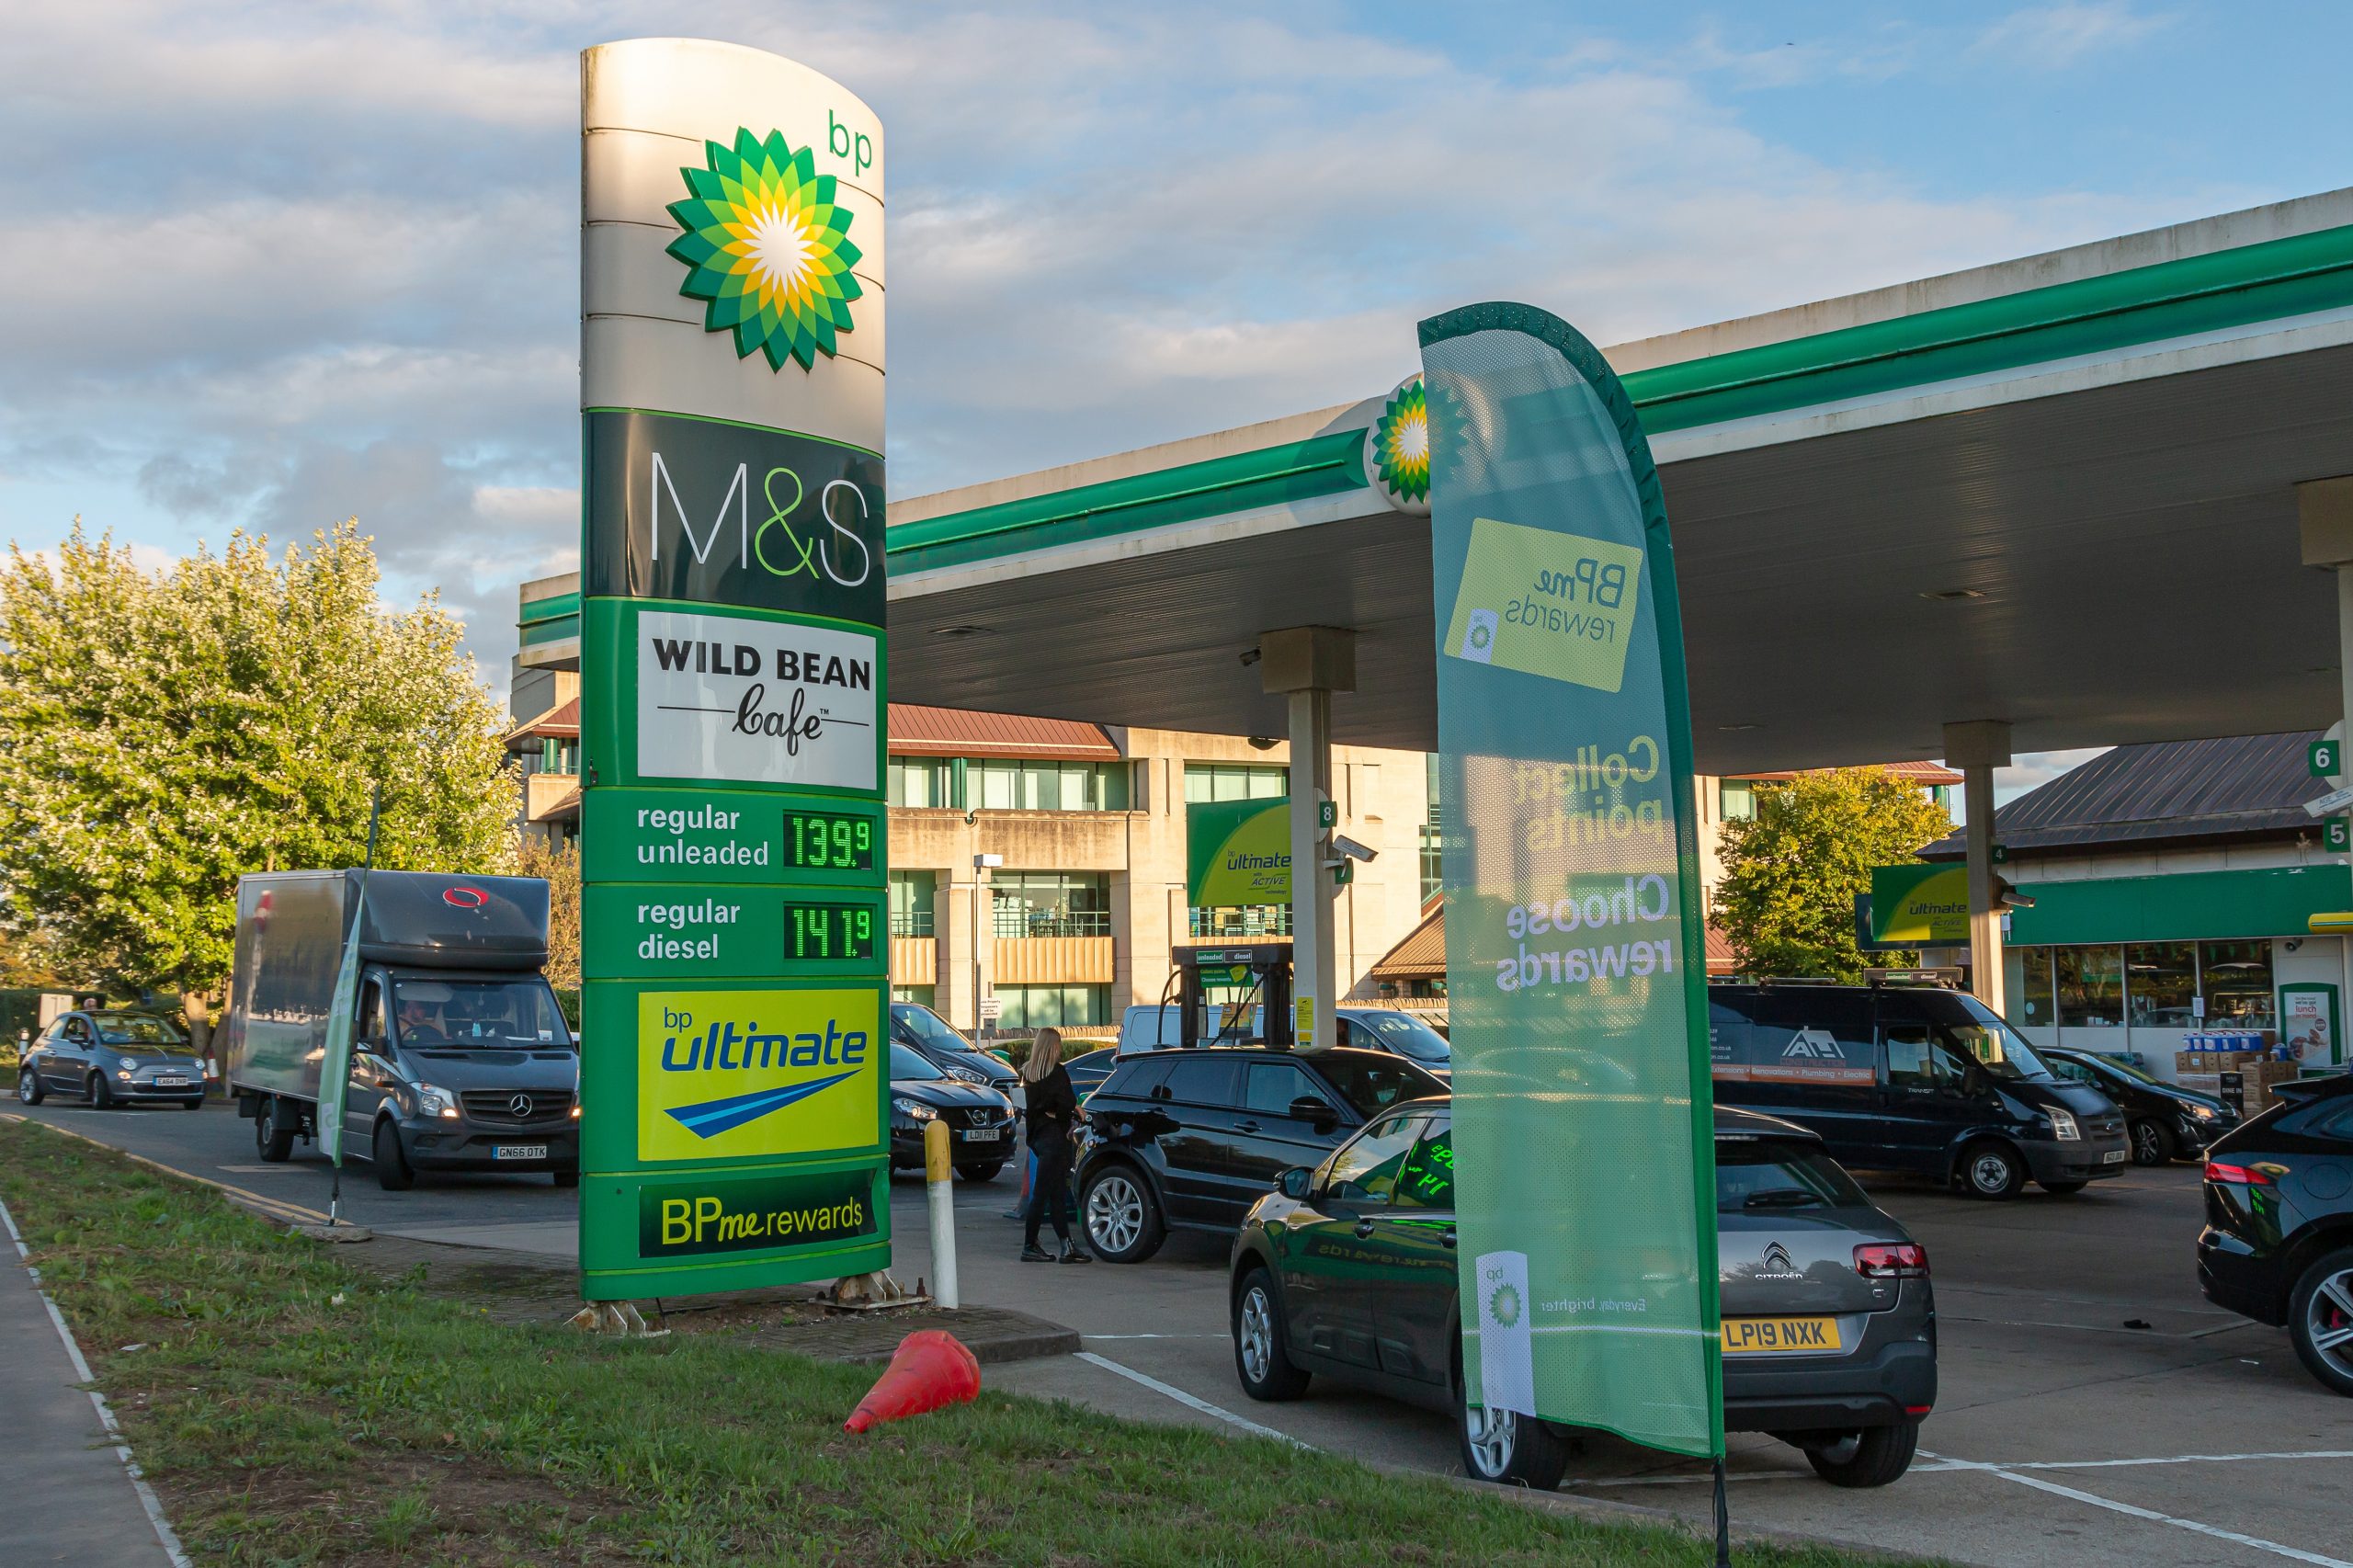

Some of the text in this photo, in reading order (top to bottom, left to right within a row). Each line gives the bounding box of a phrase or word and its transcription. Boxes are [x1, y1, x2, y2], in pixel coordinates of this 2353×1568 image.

[828, 108, 872, 177] bp
[652, 451, 870, 587] M&S
[652, 638, 870, 691] WILD BEAN
[2315, 747, 2330, 768] 6
[638, 804, 741, 835] regular
[1324, 806, 1332, 822] 8
[2330, 824, 2345, 844] 5
[638, 838, 769, 866] unleaded
[1227, 852, 1292, 870] ultimate
[1995, 848, 2003, 859] 4
[1251, 877, 1287, 886] ACTIVE
[638, 898, 741, 929] regular
[1909, 902, 1967, 915] ultimate
[638, 934, 719, 960] diesel
[1198, 953, 1222, 961] unleaded
[664, 1006, 692, 1033] bp
[661, 1018, 868, 1073] ultimate
[1751, 1067, 1793, 1076] Renovations
[1802, 1070, 1836, 1079] Plumbing
[499, 1147, 545, 1157] GN66 OTK
[662, 1196, 863, 1245] BPme rewards
[1725, 1322, 1827, 1347] LP19 NXK
